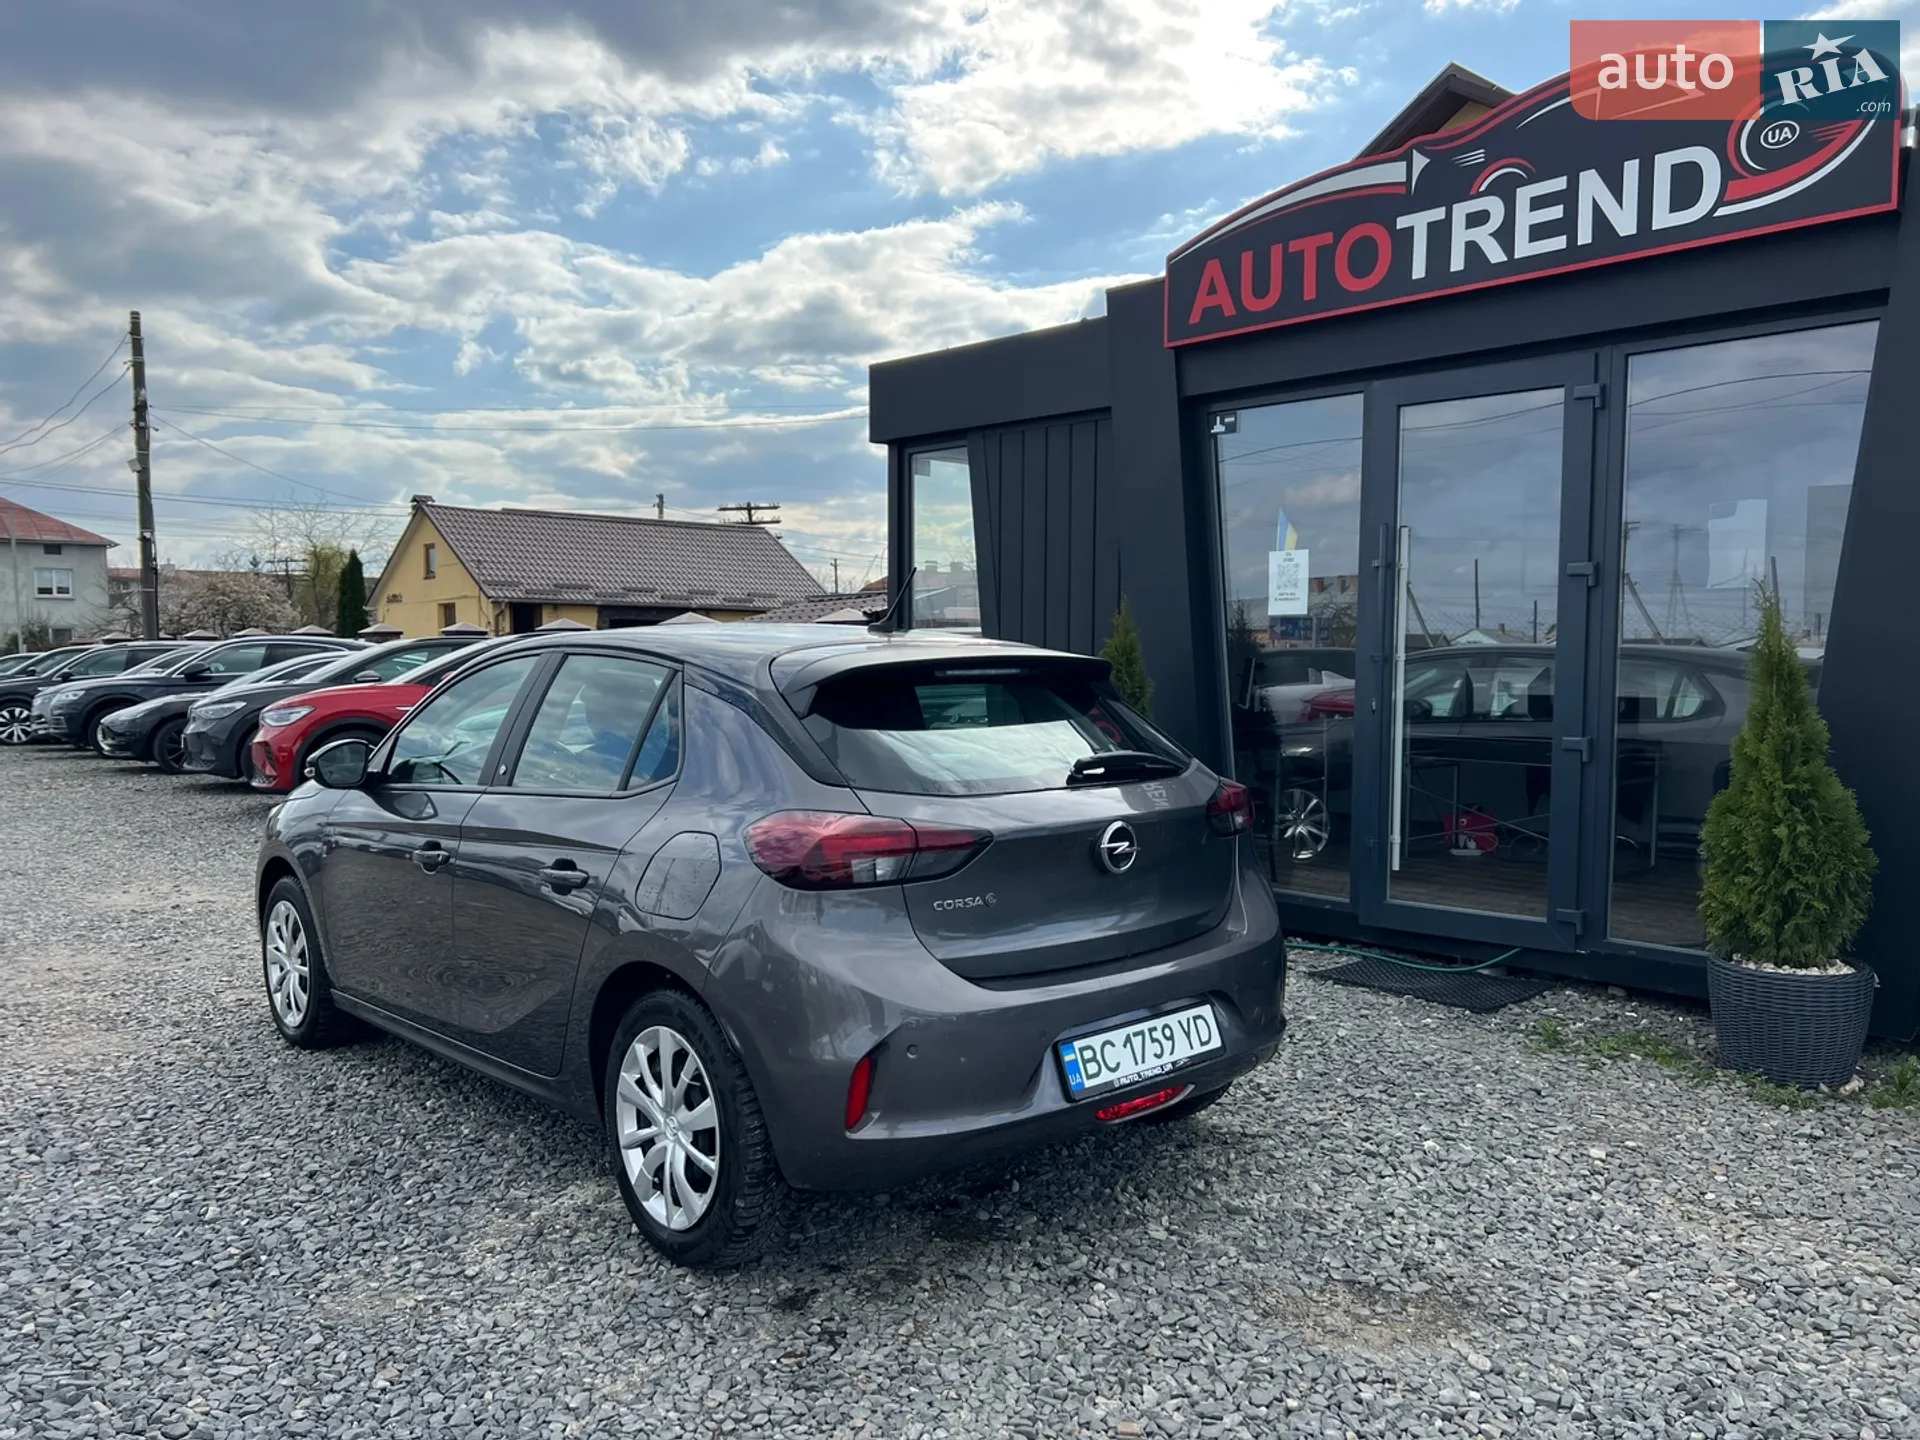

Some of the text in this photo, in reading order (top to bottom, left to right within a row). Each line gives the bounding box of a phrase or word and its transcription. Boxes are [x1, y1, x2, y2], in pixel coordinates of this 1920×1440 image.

[1767, 126, 1793, 143] UA
[933, 896, 984, 911] CORSA
[1078, 1014, 1212, 1080] BC 1759 YD
[1069, 1073, 1083, 1085] UA
